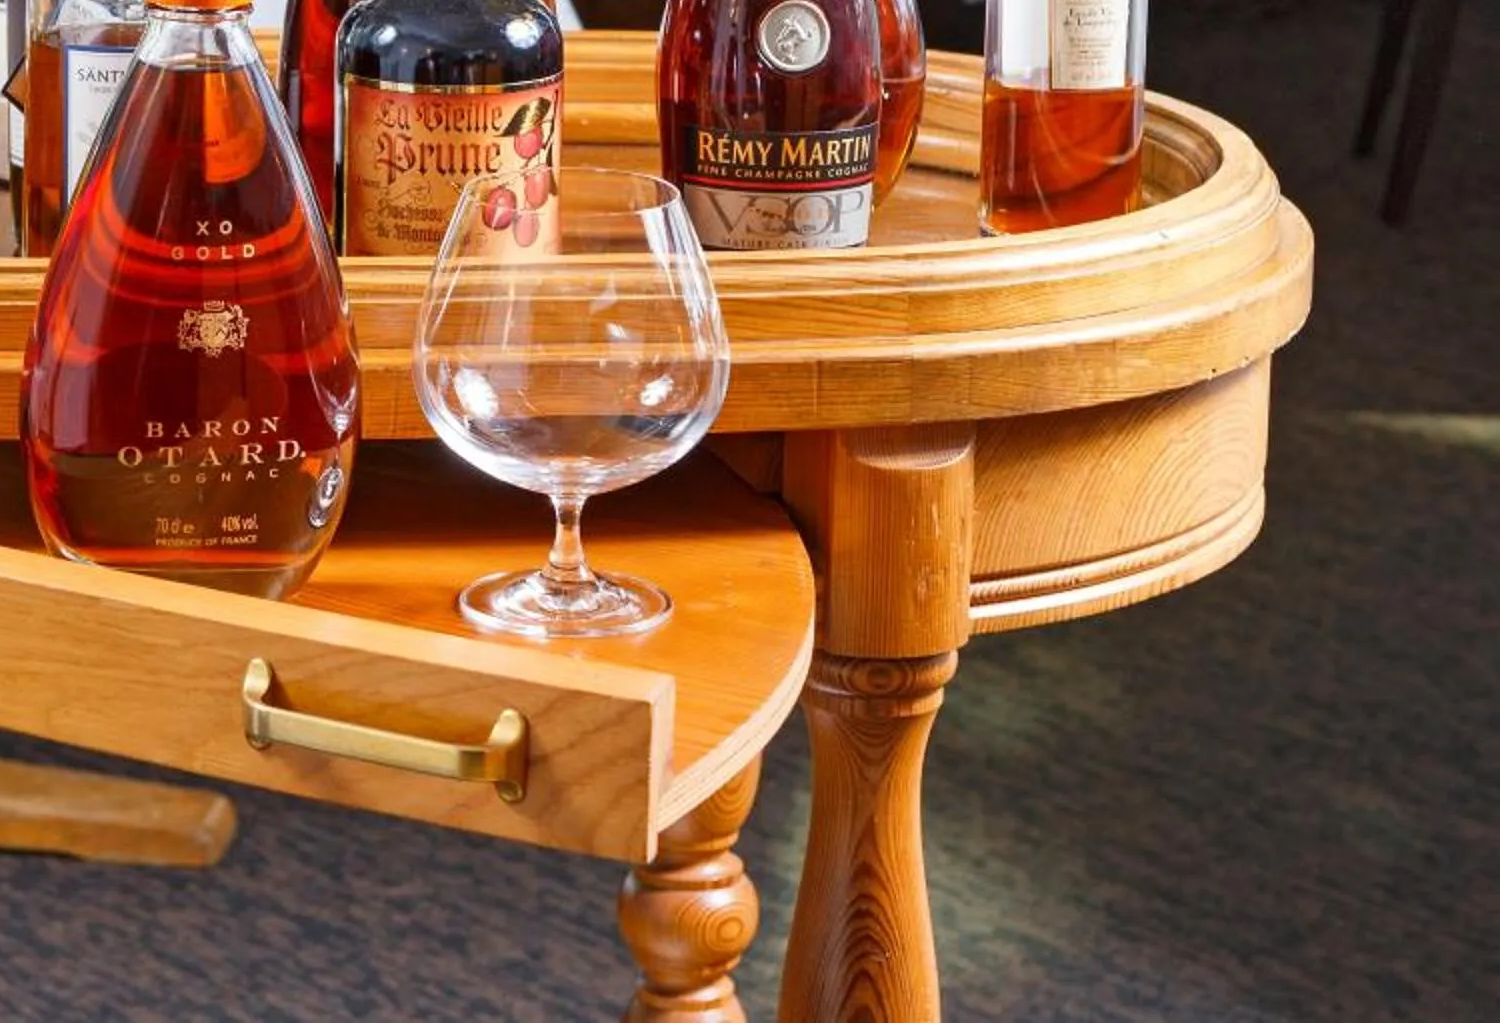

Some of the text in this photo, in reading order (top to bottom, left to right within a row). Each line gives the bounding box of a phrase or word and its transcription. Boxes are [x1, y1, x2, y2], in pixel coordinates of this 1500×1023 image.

[374, 97, 503, 133] La Vieille
[375, 132, 502, 186] Prune
[697, 129, 872, 167] RÉMY MARTIN
[697, 163, 869, 179] FINE CHAMPAGNE COGNAC
[701, 190, 865, 238] VSOP
[171, 243, 256, 261] GOLD
[146, 416, 281, 439] BARON
[143, 468, 280, 485] COGNAC
